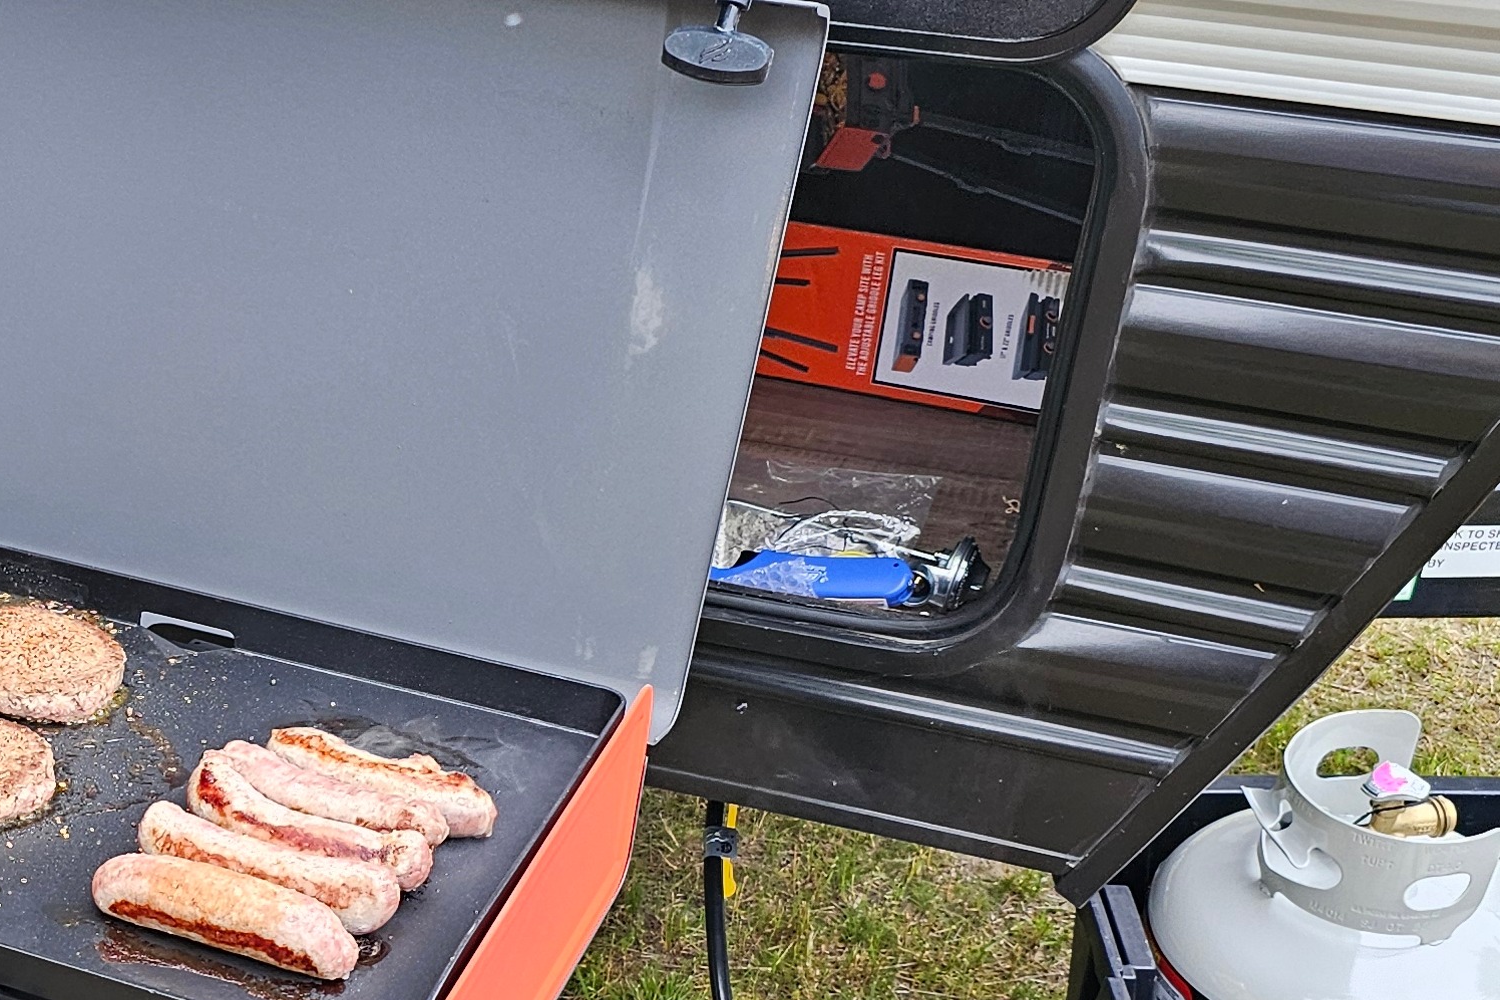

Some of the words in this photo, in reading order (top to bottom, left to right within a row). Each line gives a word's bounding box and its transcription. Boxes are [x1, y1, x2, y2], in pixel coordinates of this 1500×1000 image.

[861, 254, 874, 274] WITH
[874, 251, 886, 265] KIT
[872, 265, 884, 281] LEG
[859, 275, 871, 293] SITE
[855, 294, 867, 315] CAMP
[866, 280, 881, 314] GRIDDLE
[851, 318, 863, 338] YOUR
[859, 315, 875, 361] ADJUSTABLE
[845, 339, 860, 370] ELEVATE
[856, 361, 868, 376] THE
[1468, 529, 1485, 539] TO
[1487, 529, 1500, 539] S
[1440, 541, 1500, 551] NSPECTE
